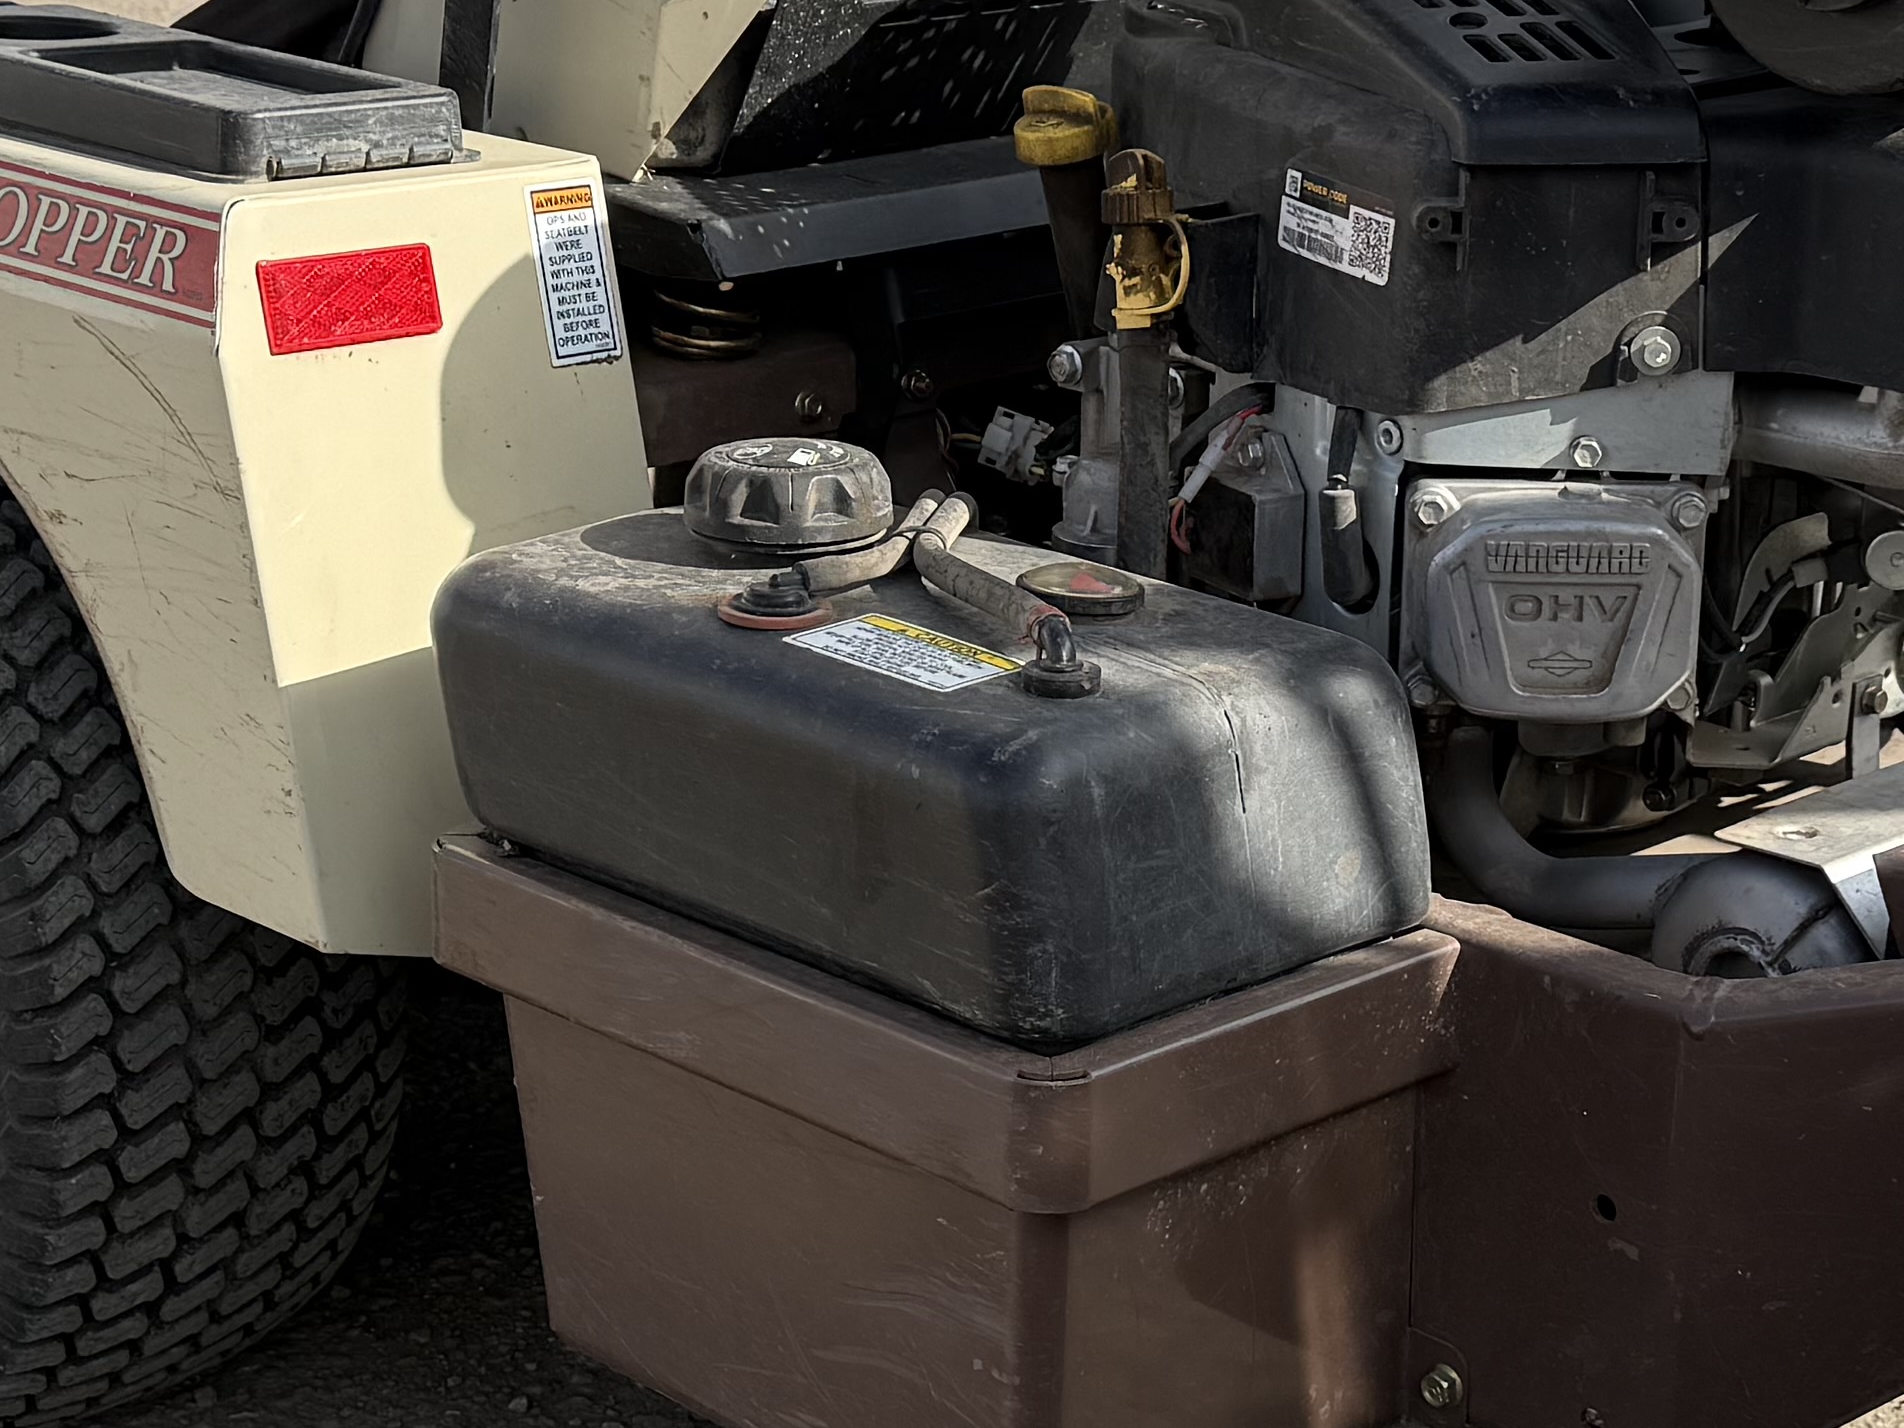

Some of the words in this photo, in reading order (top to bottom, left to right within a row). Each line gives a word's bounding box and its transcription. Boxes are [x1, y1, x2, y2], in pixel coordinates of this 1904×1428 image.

[544, 193, 591, 207] WARNING
[568, 212, 586, 223] AND
[544, 225, 589, 240] SEATBELT
[554, 239, 583, 252] WERE
[548, 251, 593, 266] SUPPLIED
[550, 267, 573, 280] WITH
[575, 264, 595, 276] THIS
[551, 278, 593, 293] MACHINE
[557, 293, 582, 306] MUST
[585, 291, 599, 302] BE
[556, 304, 605, 320] INSTALLED
[563, 318, 600, 333] BEFORE
[558, 330, 610, 348] OPERATION
[1485, 540, 1650, 575] VANGUARD
[1504, 593, 1627, 623] OHV
